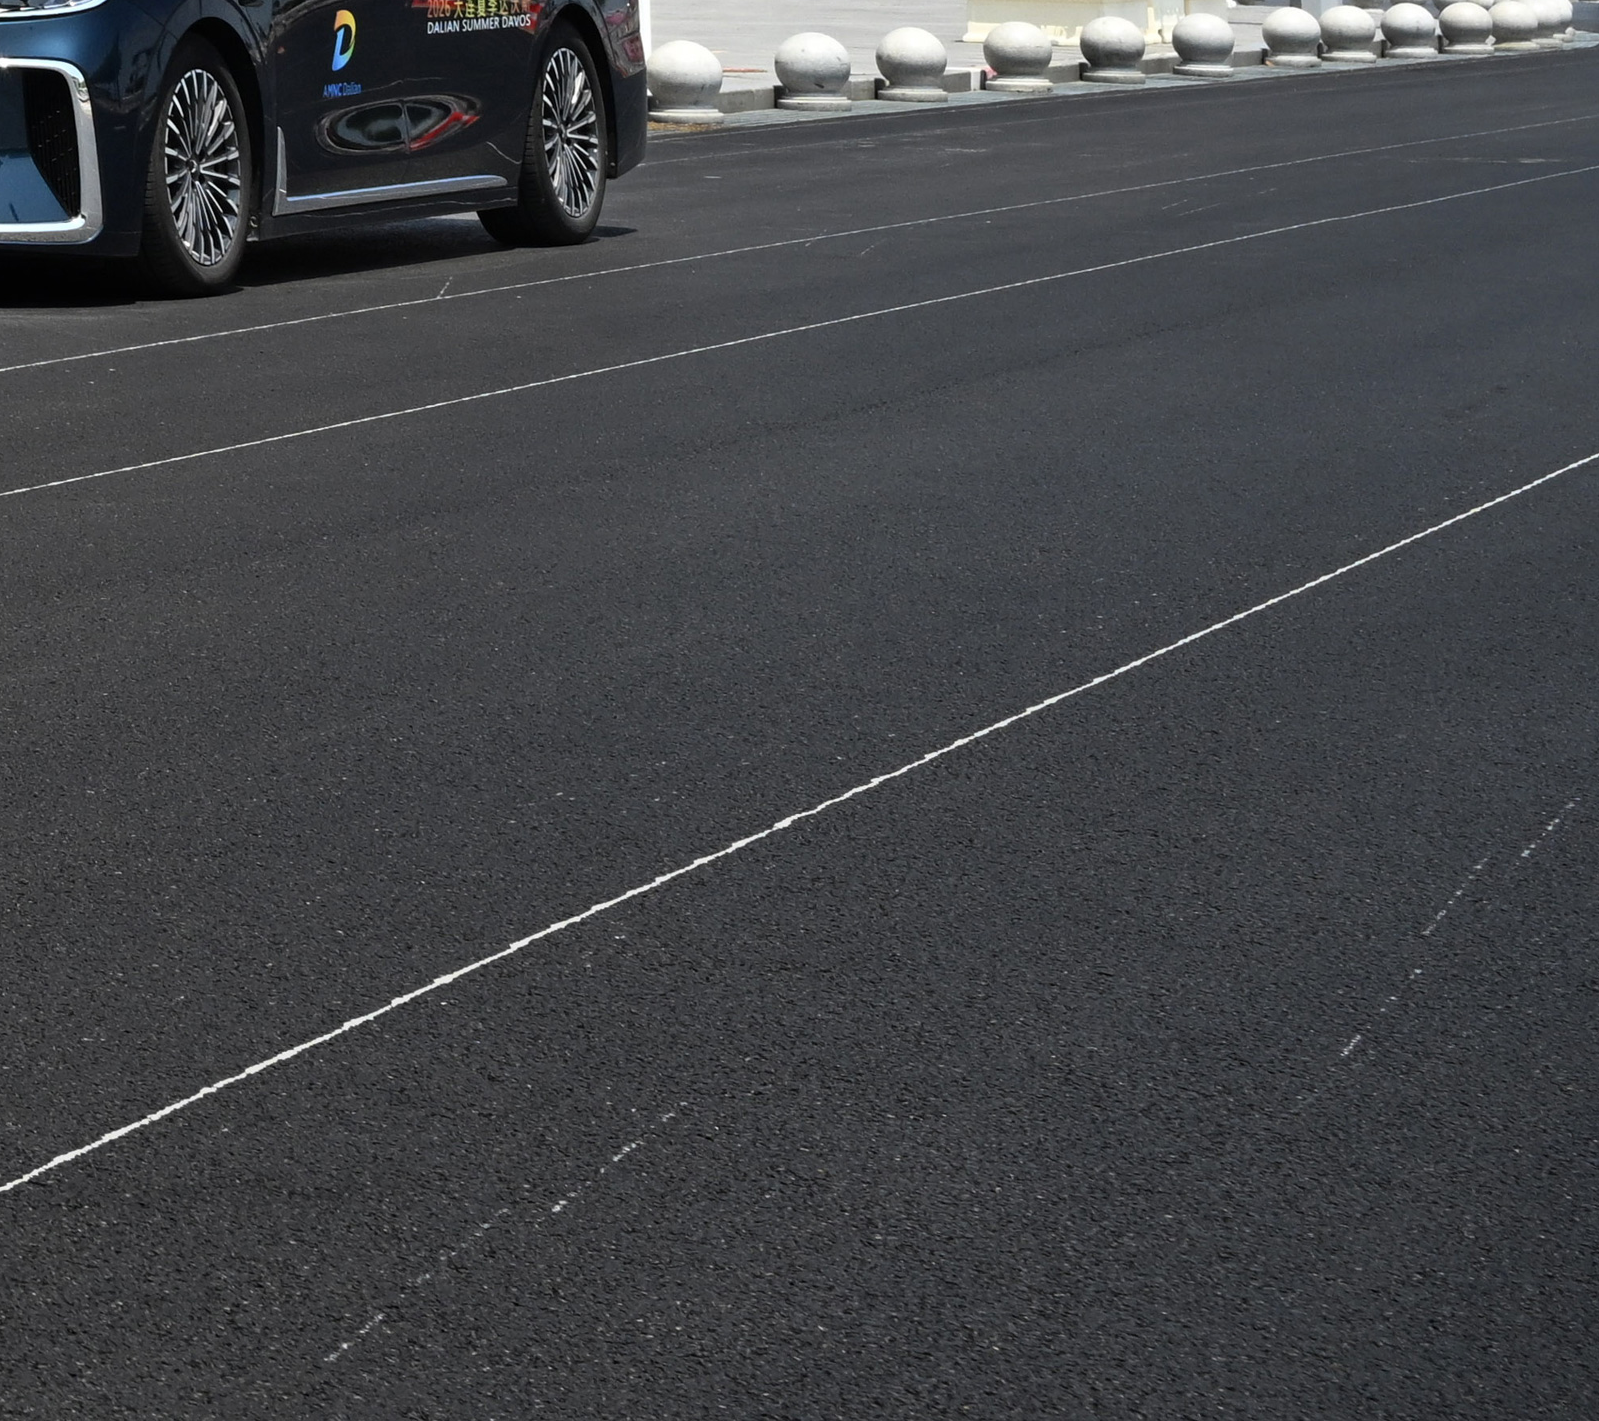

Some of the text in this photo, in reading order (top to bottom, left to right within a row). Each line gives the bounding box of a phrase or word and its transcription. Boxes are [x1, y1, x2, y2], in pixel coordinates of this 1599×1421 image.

[427, 14, 531, 34] DALIAN SUMMER DAVOS
